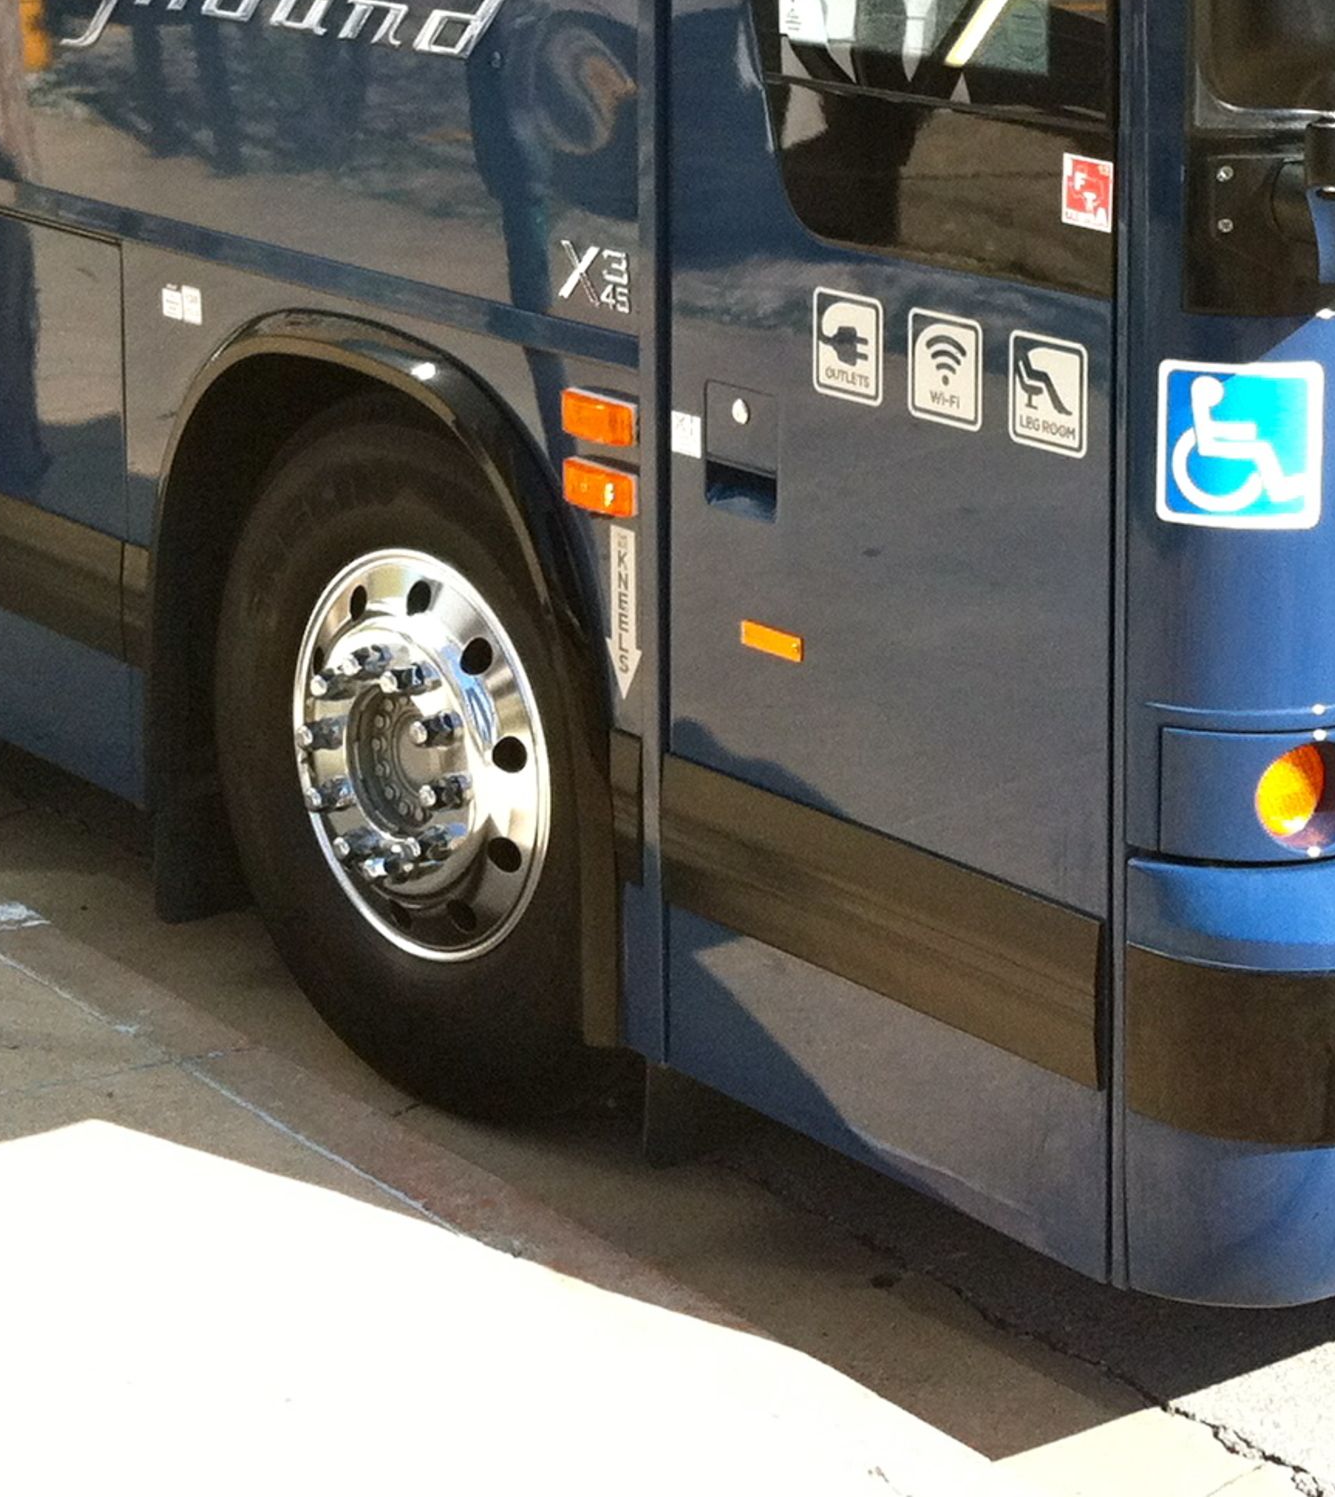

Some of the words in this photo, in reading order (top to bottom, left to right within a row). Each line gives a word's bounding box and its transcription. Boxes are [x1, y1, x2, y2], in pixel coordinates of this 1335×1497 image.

[824, 366, 870, 388] OUTLETS
[930, 390, 961, 410] Wi-Fi
[1019, 414, 1041, 432] LEG
[1042, 420, 1076, 441] ROOM
[617, 550, 630, 674] KNEELS
